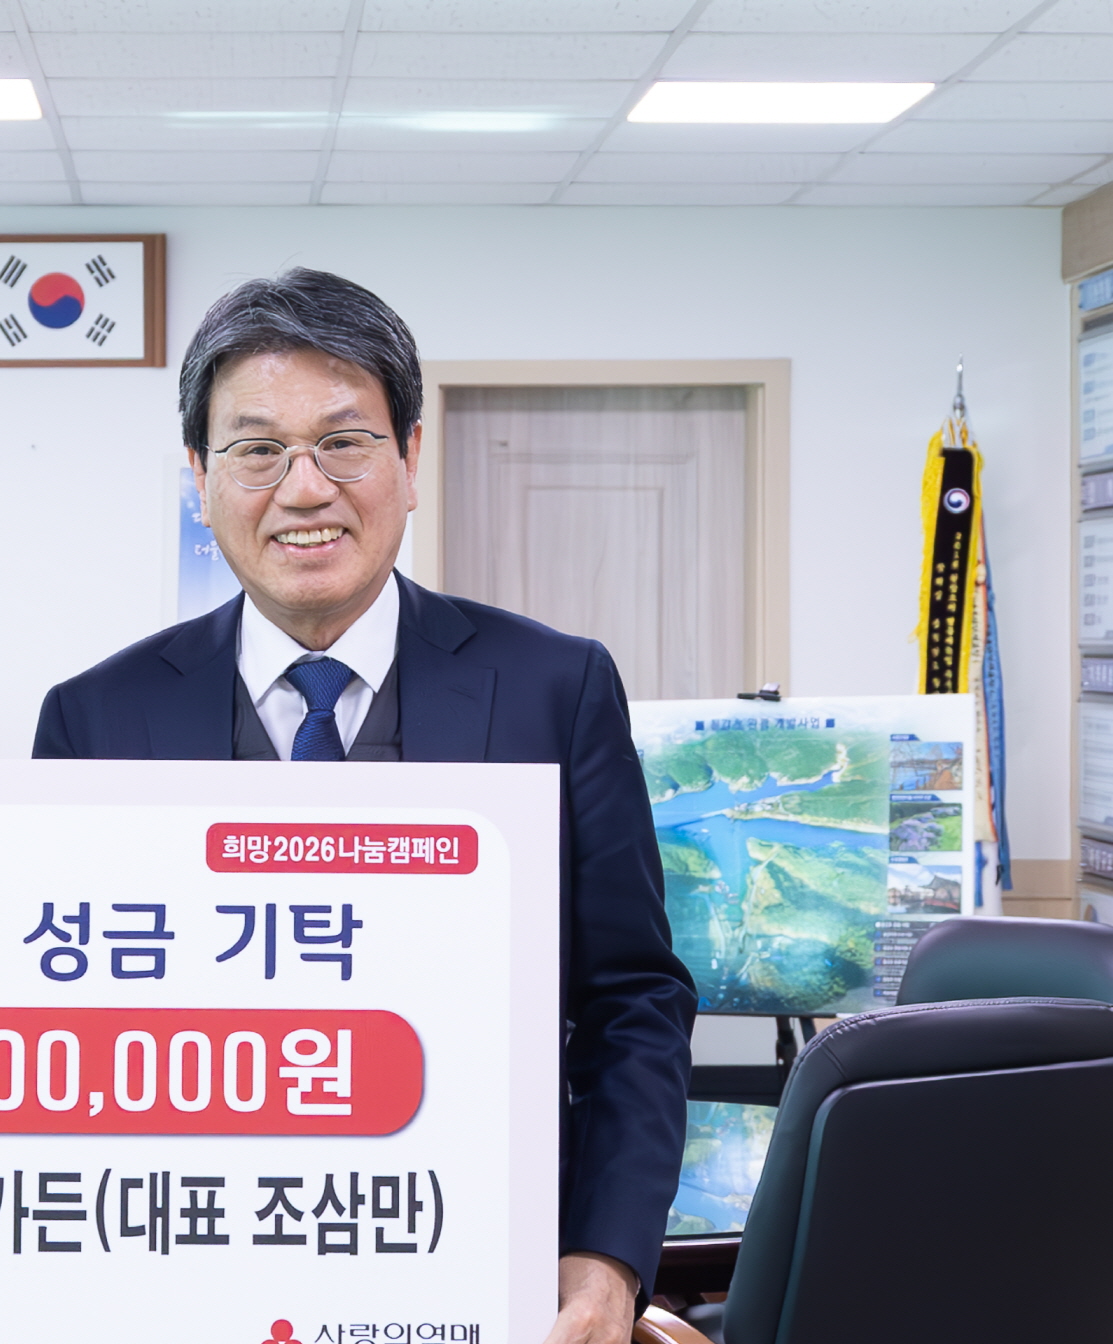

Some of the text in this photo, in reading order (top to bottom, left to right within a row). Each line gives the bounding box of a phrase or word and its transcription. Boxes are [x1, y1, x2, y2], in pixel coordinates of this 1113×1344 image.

[222, 835, 459, 864] 희망2026나눔캠페인
[22, 901, 176, 982] 성금
[215, 902, 364, 982] 기탁
[252, 1169, 444, 1256] 조삼만)
